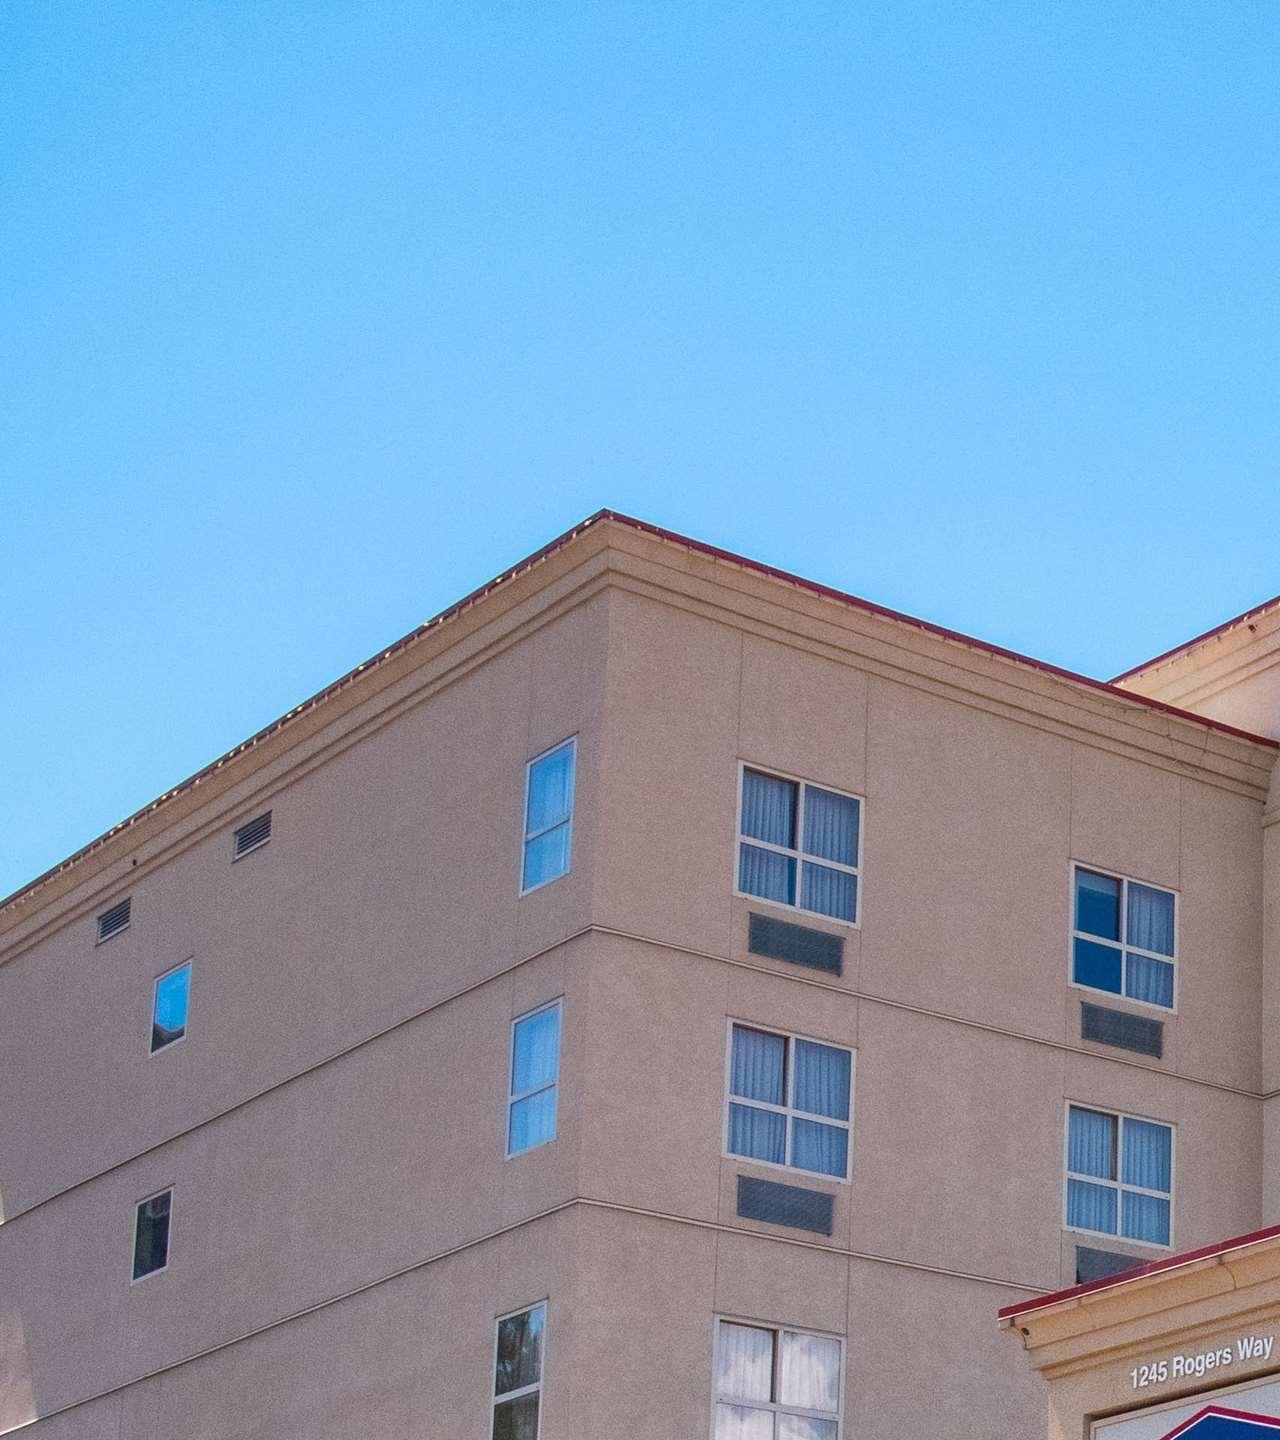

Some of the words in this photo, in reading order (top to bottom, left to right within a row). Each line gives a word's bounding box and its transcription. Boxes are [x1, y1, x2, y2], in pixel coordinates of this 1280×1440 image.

[1130, 1360, 1168, 1389] 1245
[1172, 1347, 1232, 1377] Rogers
[1237, 1336, 1273, 1360] Way
